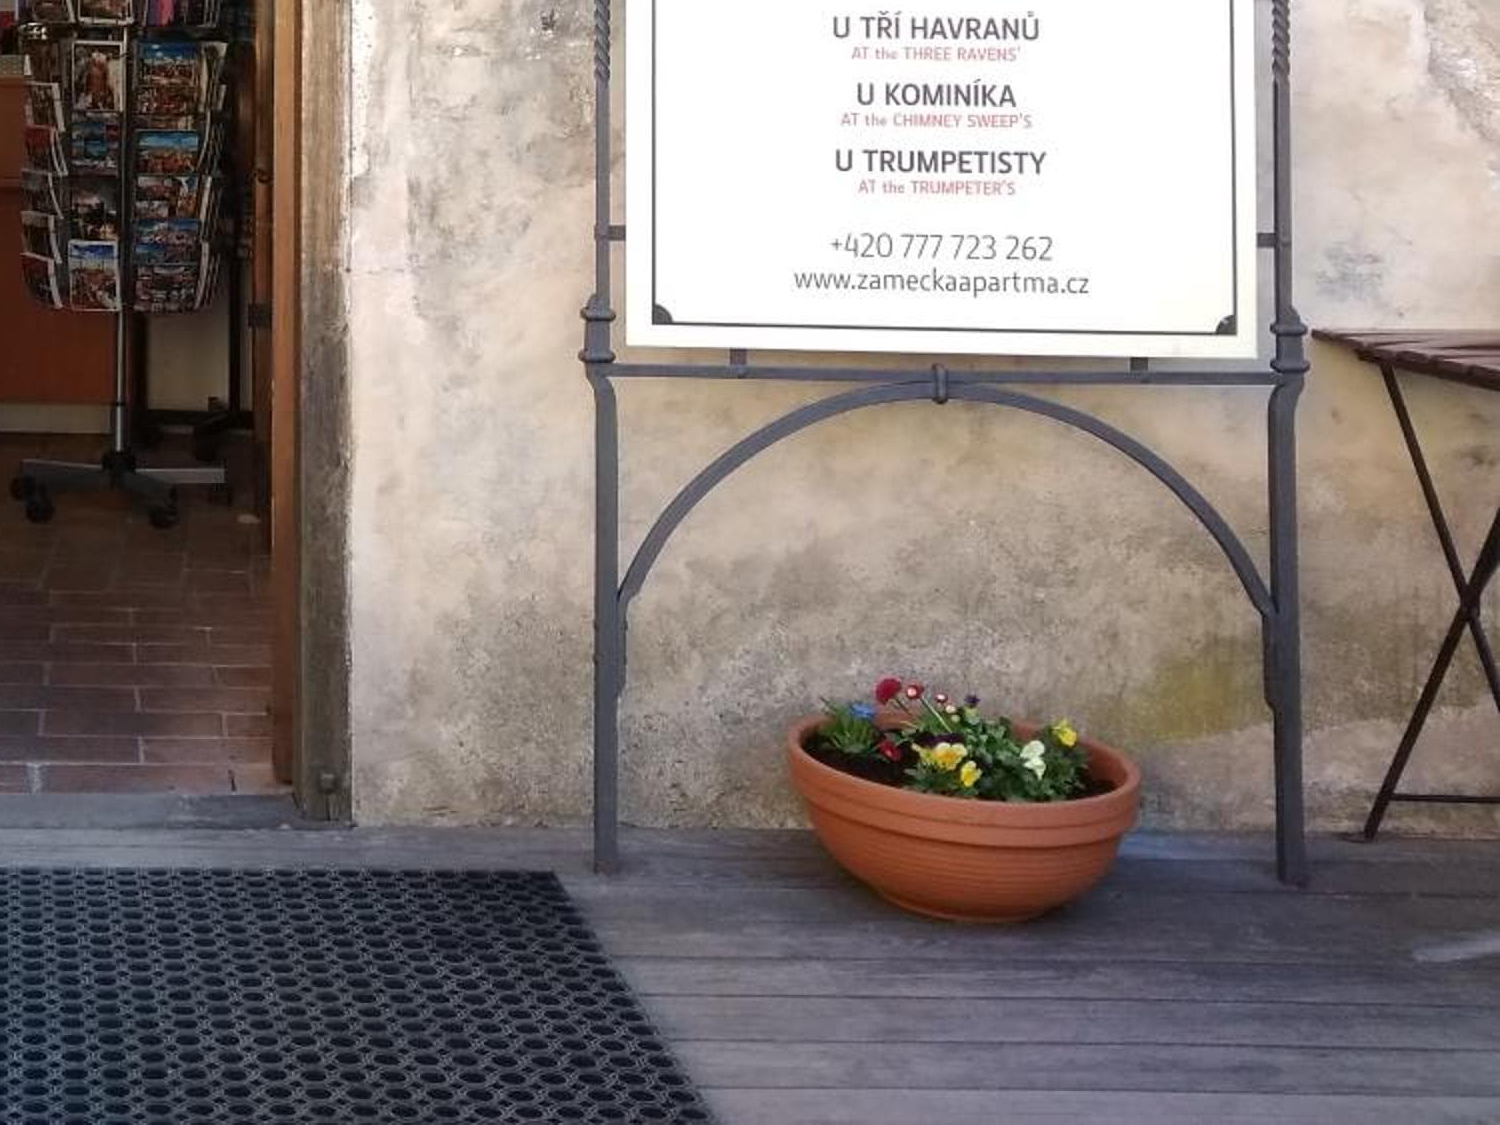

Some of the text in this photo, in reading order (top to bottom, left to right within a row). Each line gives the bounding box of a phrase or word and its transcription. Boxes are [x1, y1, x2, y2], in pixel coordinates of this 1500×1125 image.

[833, 9, 1039, 41] U TŘÍ HAVRANŮ
[852, 46, 869, 59] AT
[875, 47, 897, 59] the
[904, 47, 951, 61] THREE
[857, 79, 1016, 107] U KOMINÍKA
[841, 112, 1032, 128] AT the CHIMNEY SWEEP'S
[836, 149, 1046, 174] U TRUMPETISTY
[858, 180, 1015, 195] AT the TRUMPETER'S
[831, 233, 1052, 261] +420 777 723 262
[794, 267, 1089, 298] www.zameckaapartma.cz
